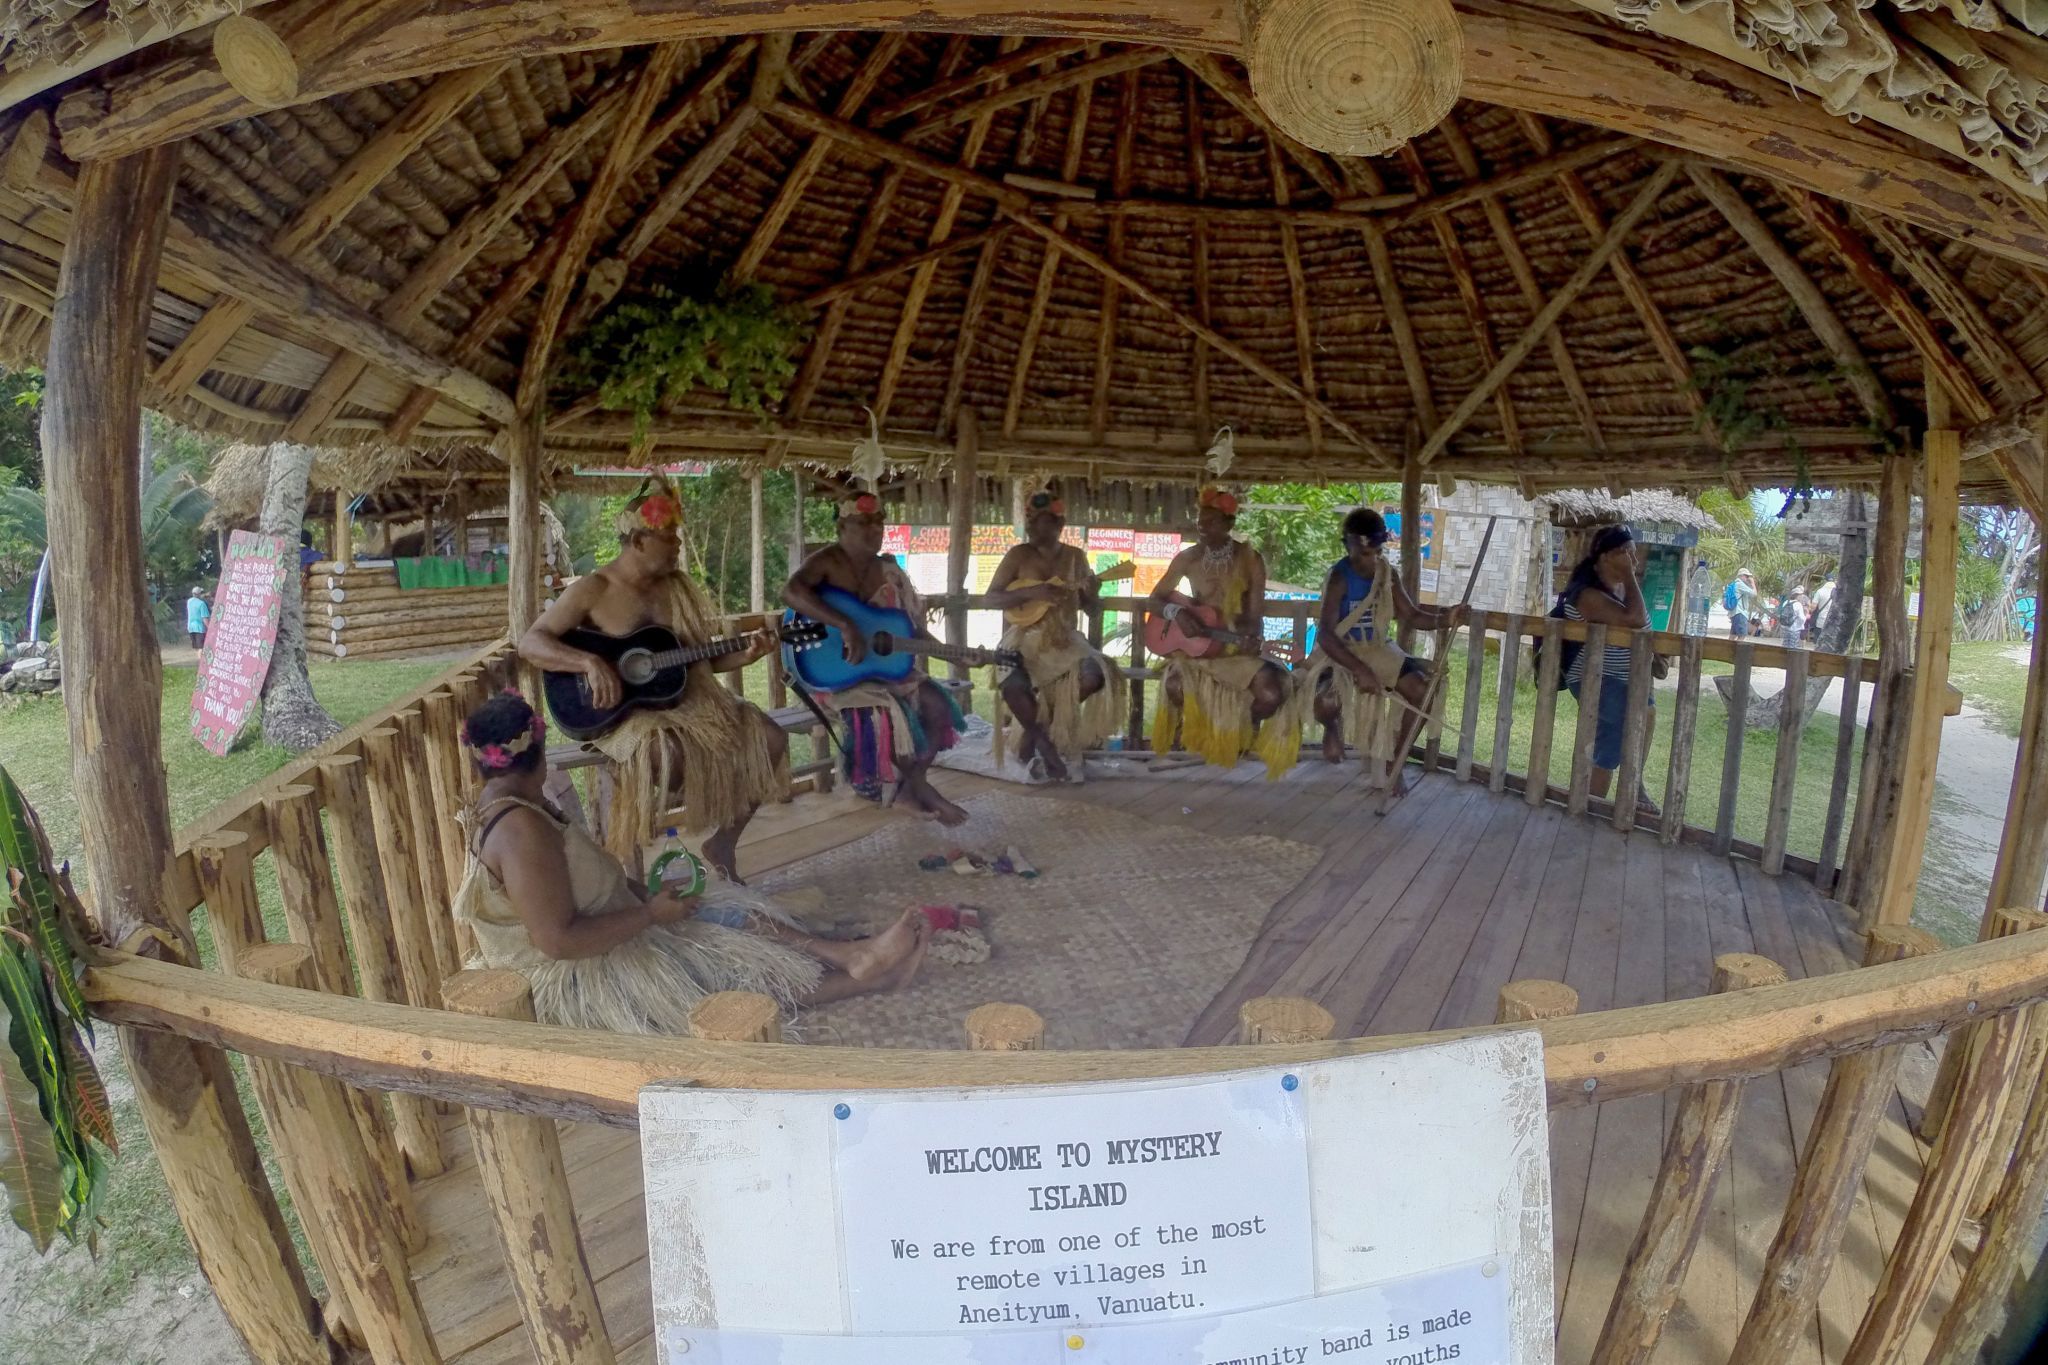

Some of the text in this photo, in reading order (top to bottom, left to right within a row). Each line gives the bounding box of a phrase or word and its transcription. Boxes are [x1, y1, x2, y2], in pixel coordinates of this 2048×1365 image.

[971, 525, 1015, 538] SUPER
[1089, 528, 1134, 539] BEGINNERS
[1145, 533, 1172, 544] FISH
[1642, 531, 1676, 546] TOUR SHOP
[1135, 543, 1179, 555] FEEDING
[203, 696, 226, 720] THANK
[924, 1130, 1223, 1175] WELCOME TO MYSTERY
[1027, 1181, 1127, 1211] ISLAND
[890, 1215, 1267, 1259] We are from one of the most
[956, 1255, 1208, 1291] remote villages in
[958, 1291, 1205, 1324] Aneityum, Vanuatu.
[1208, 1309, 1472, 1365] unity band is made
